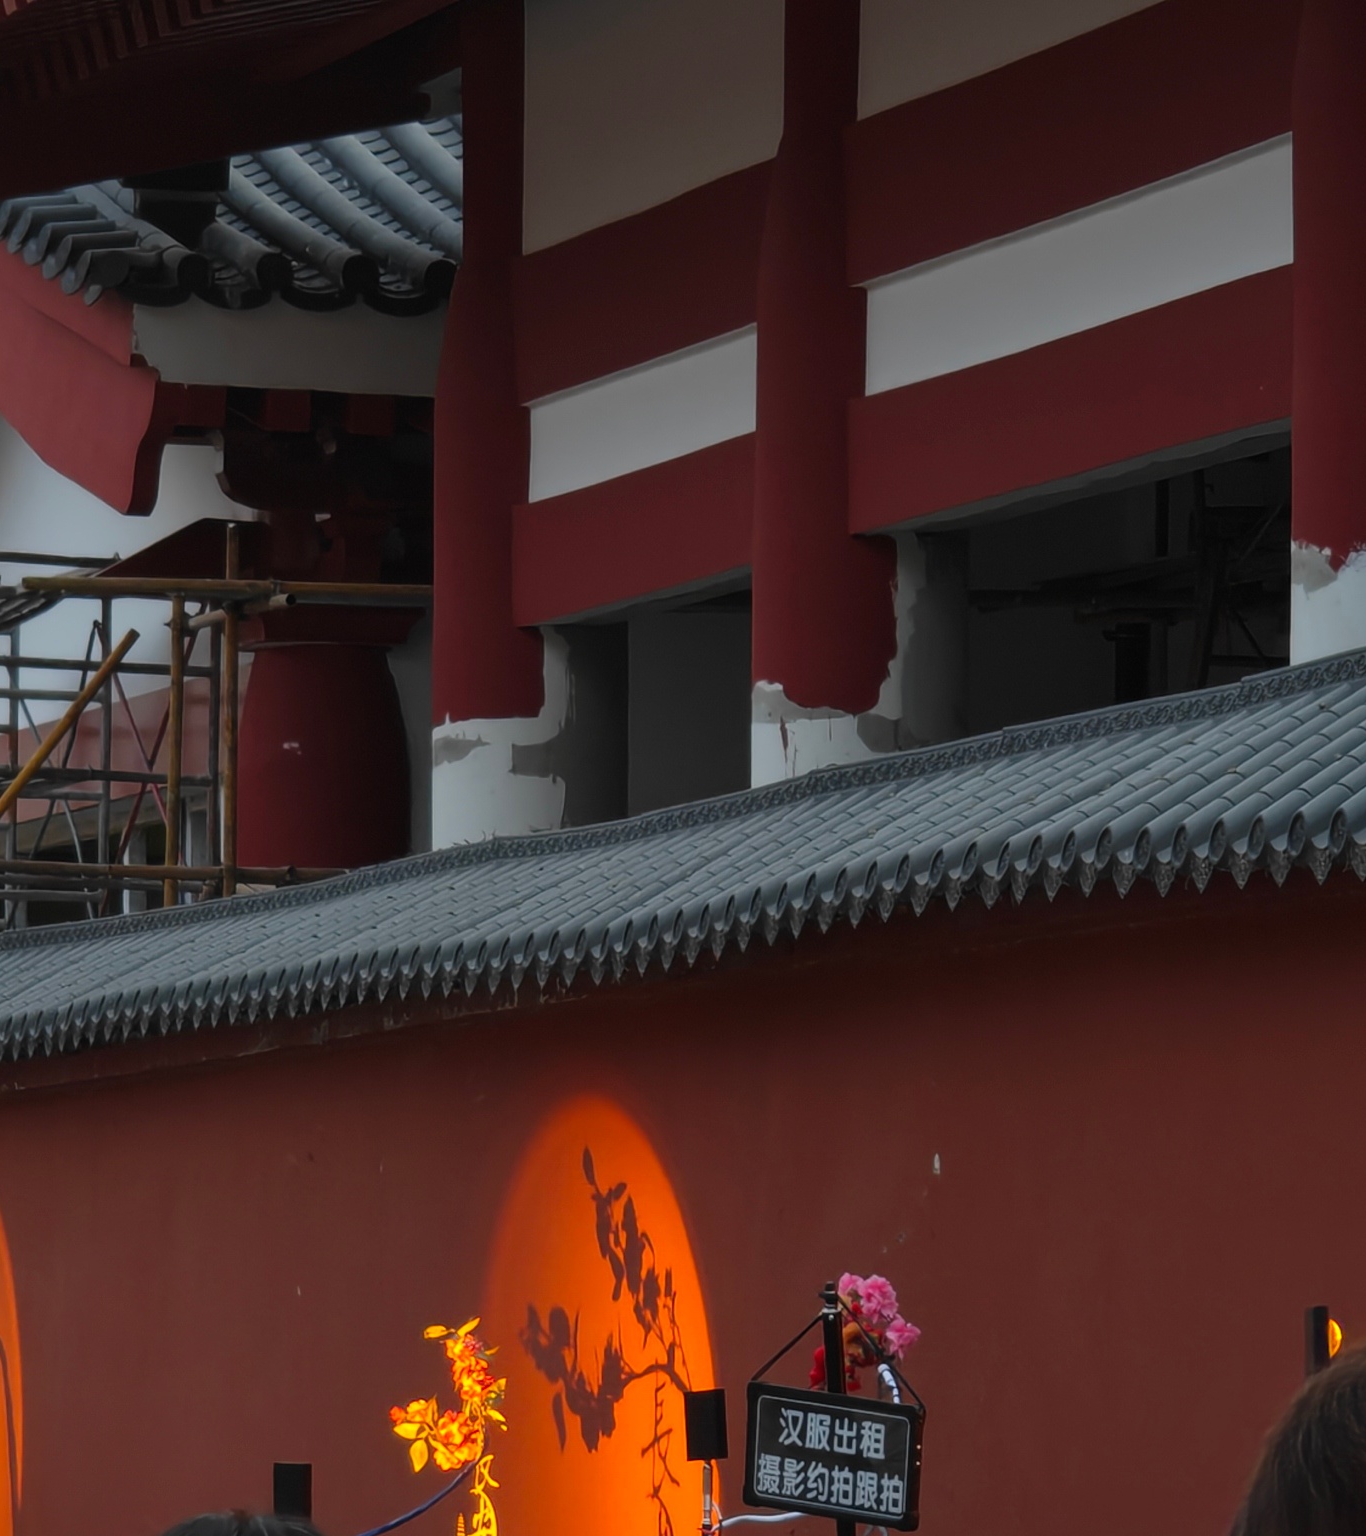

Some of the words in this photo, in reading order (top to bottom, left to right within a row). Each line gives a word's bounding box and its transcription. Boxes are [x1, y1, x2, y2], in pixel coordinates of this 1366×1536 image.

[778, 1407, 885, 1460] 汉服出租
[757, 1453, 904, 1514] 摄影约拍跟拍
